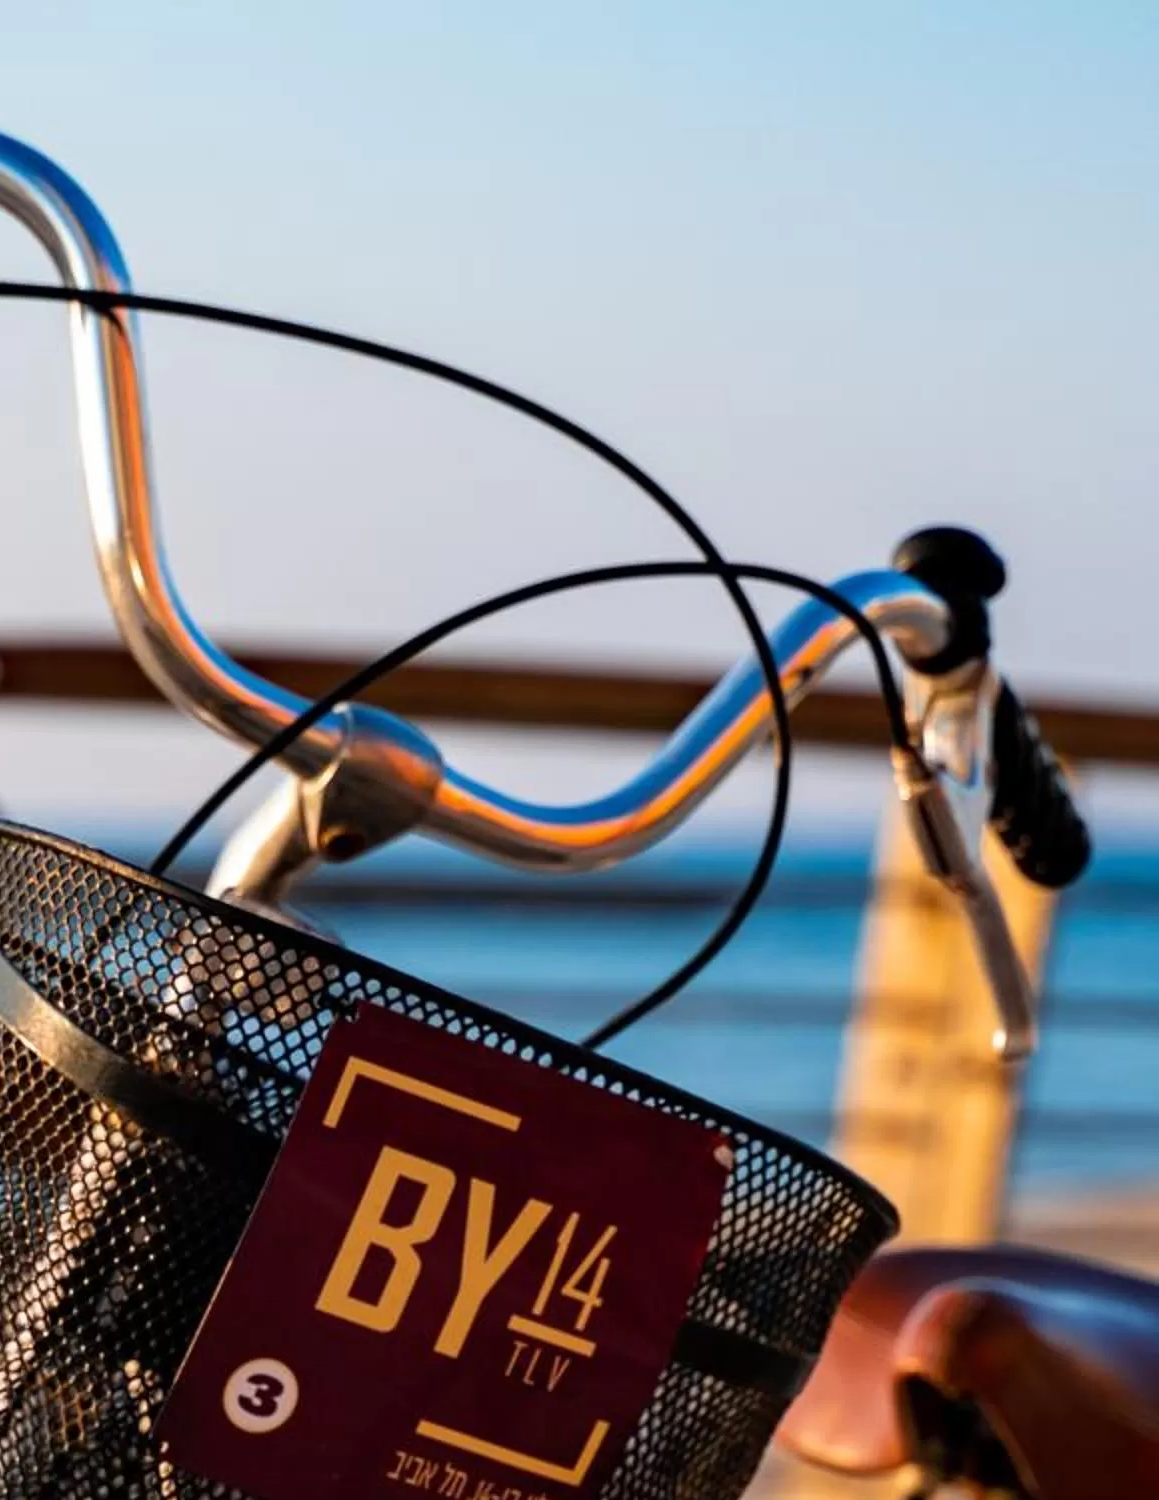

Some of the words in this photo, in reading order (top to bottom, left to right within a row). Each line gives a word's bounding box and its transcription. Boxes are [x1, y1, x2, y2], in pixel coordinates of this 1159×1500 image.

[315, 1145, 553, 1359] BY
[532, 1211, 618, 1332] 14
[504, 1340, 571, 1393] TLV
[236, 1373, 286, 1418] 3
[386, 1451, 440, 1490] אביב
[438, 1461, 468, 1500] תל
